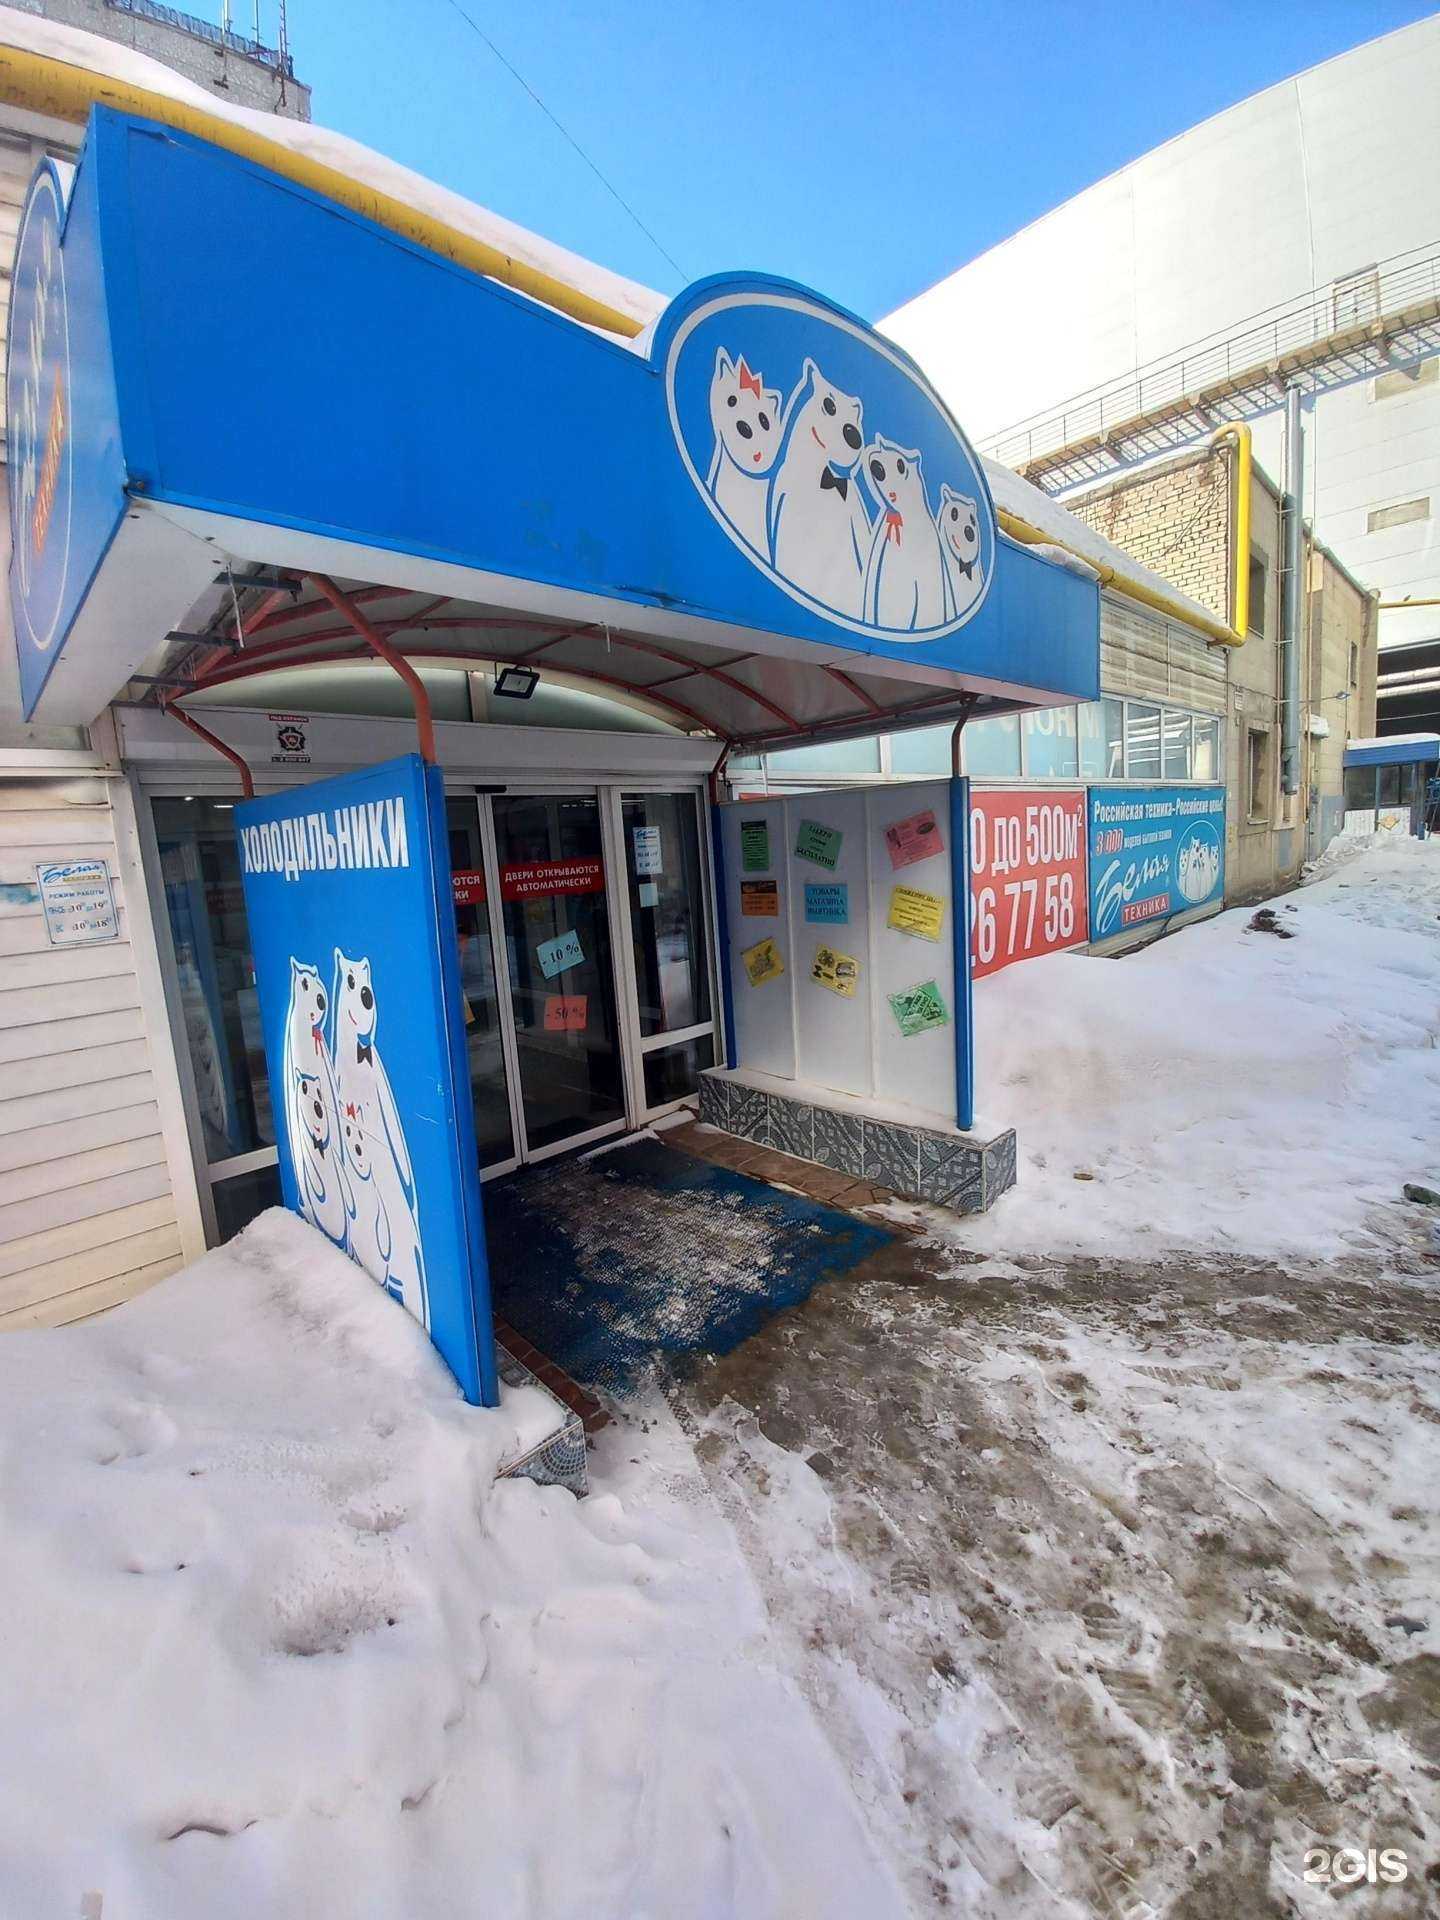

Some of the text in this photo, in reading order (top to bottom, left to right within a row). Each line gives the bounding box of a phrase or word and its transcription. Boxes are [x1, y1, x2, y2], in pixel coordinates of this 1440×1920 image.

[1094, 800, 1143, 823] Российская
[240, 797, 409, 881] ХОЛОДИЛЬНИКИ
[991, 816, 1021, 877] до
[505, 865, 599, 882] ДВЕРИ ОТКРЫВАЮТСЯ
[516, 877, 591, 892] АВТОМАТИЧЕСКИ
[77, 889, 104, 897] РАБОТЫ
[1095, 854, 1169, 933] Белая
[1004, 878, 1038, 956] 77
[1044, 872, 1074, 943] 58
[1125, 898, 1168, 921] ТЕХНИКА
